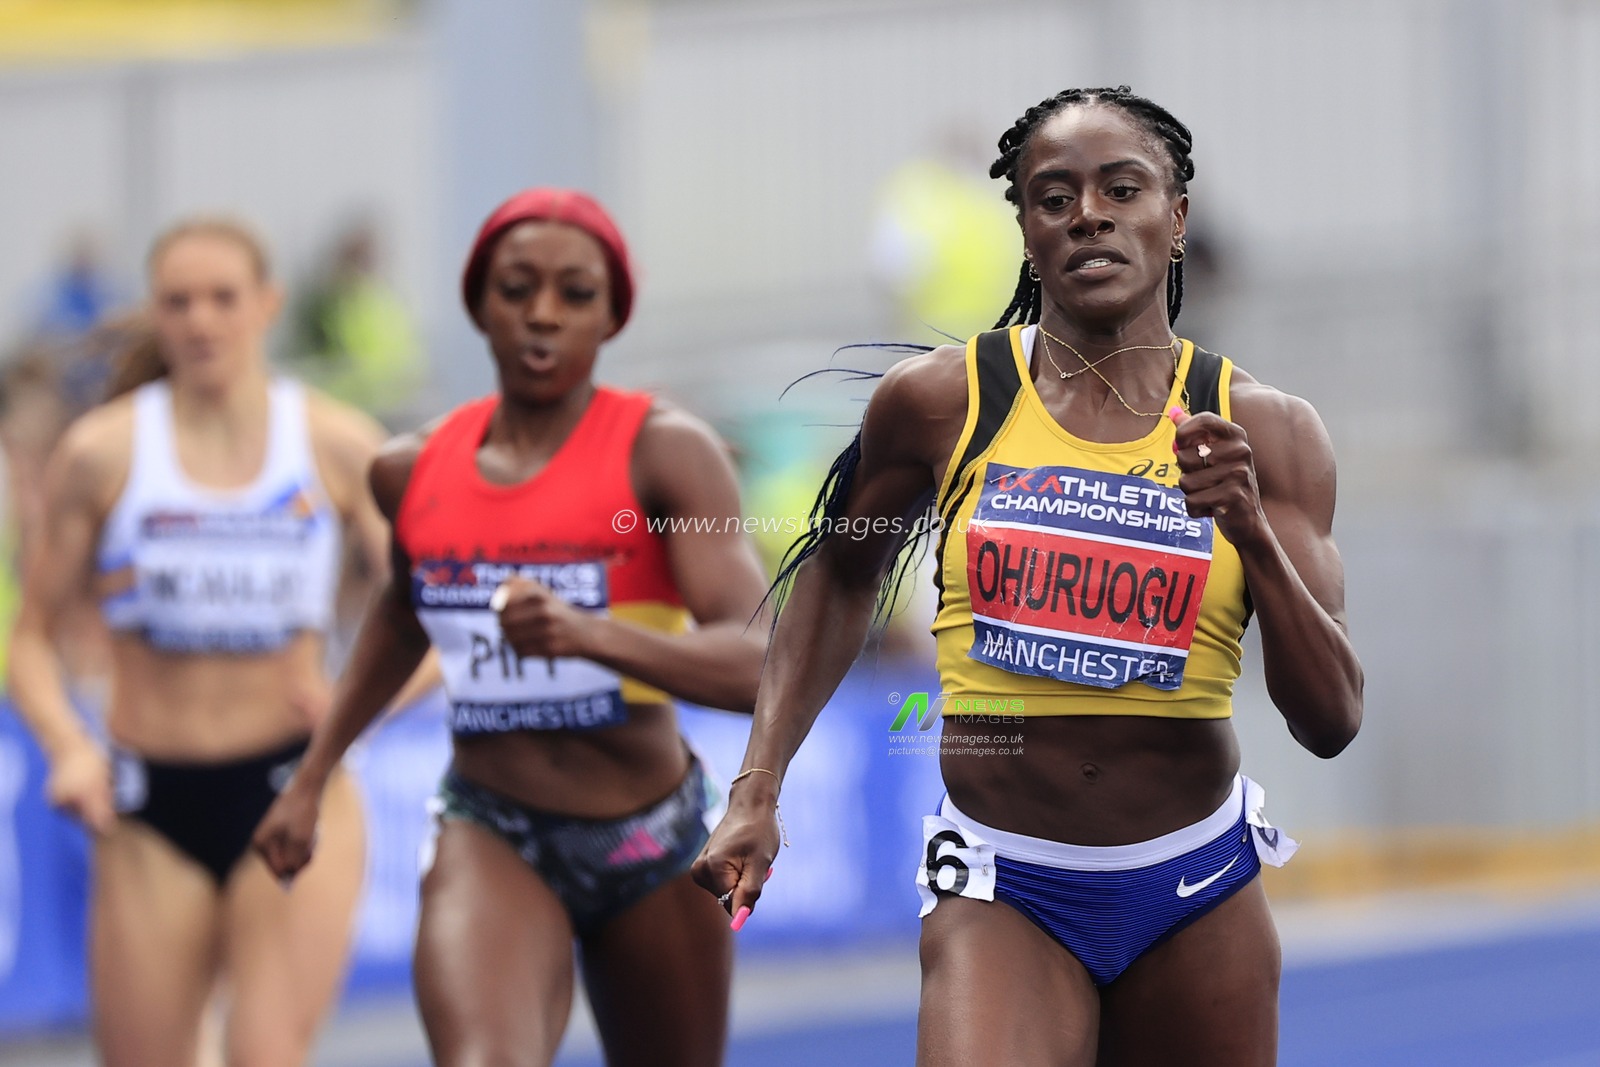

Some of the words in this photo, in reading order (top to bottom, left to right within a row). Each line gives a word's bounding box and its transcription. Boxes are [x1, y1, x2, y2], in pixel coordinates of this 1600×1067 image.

[990, 494, 1202, 538] CHAMPIONSHIPS
[976, 540, 1196, 632] OHURUOGU
[926, 829, 969, 895] 6
